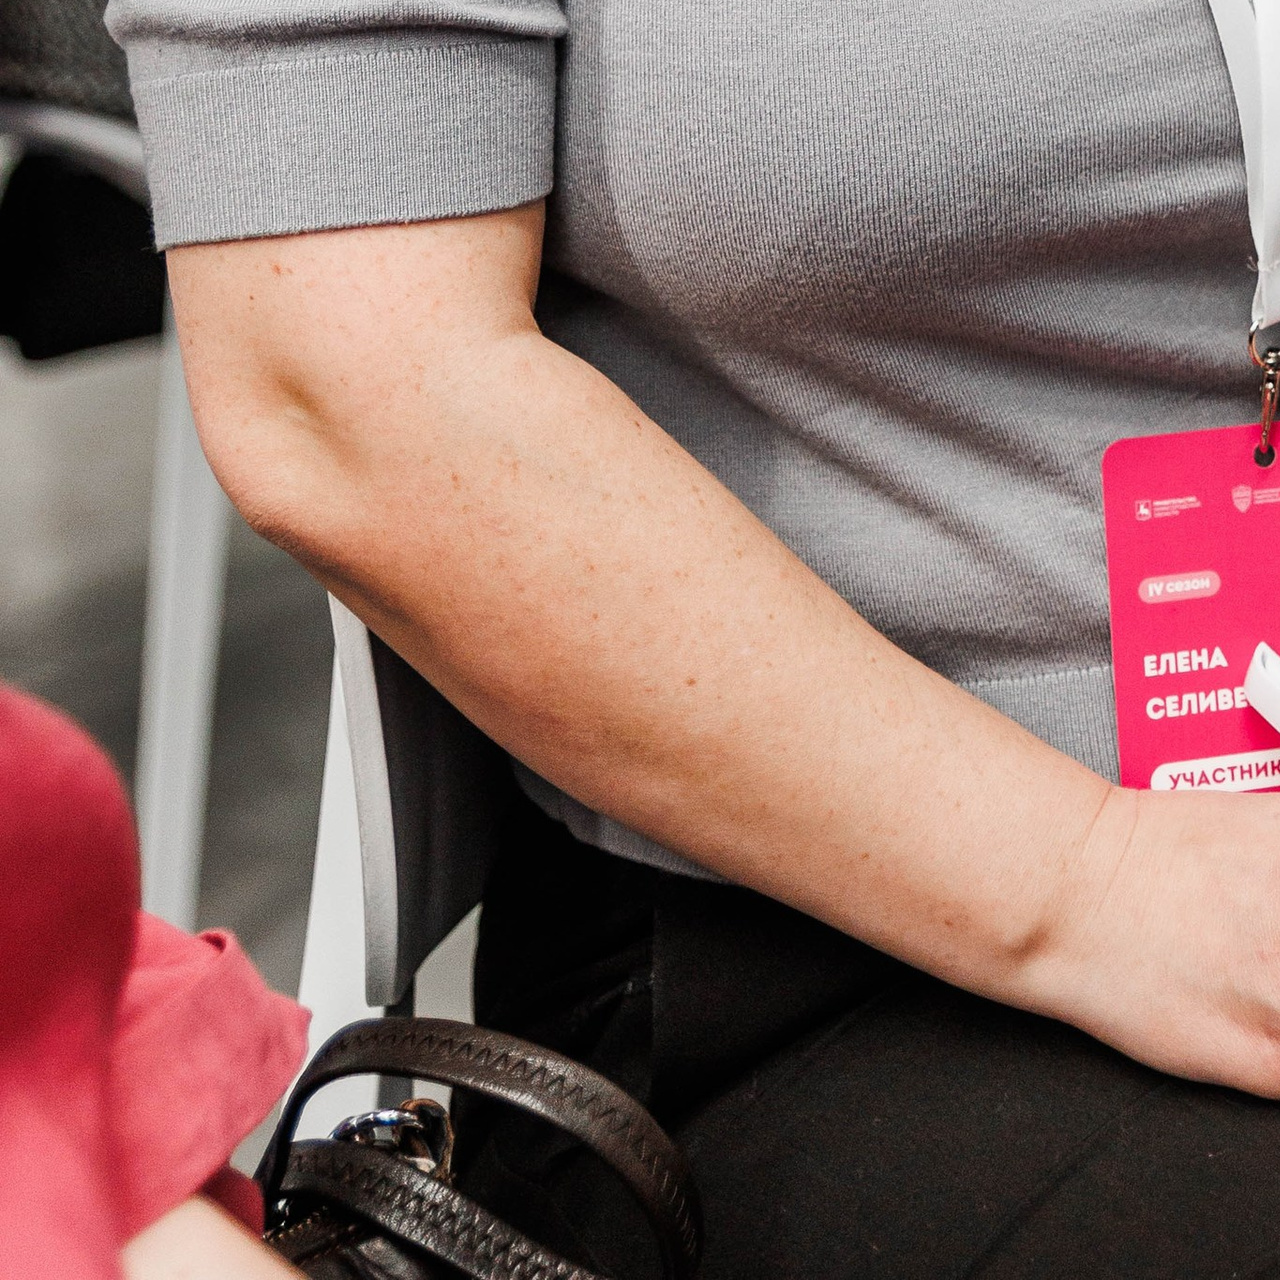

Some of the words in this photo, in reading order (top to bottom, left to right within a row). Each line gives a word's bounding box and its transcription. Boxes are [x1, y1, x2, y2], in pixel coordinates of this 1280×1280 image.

[1147, 581, 1164, 597] IV
[1165, 577, 1211, 593] сезон
[1143, 646, 1229, 678] ЕЛЕНА
